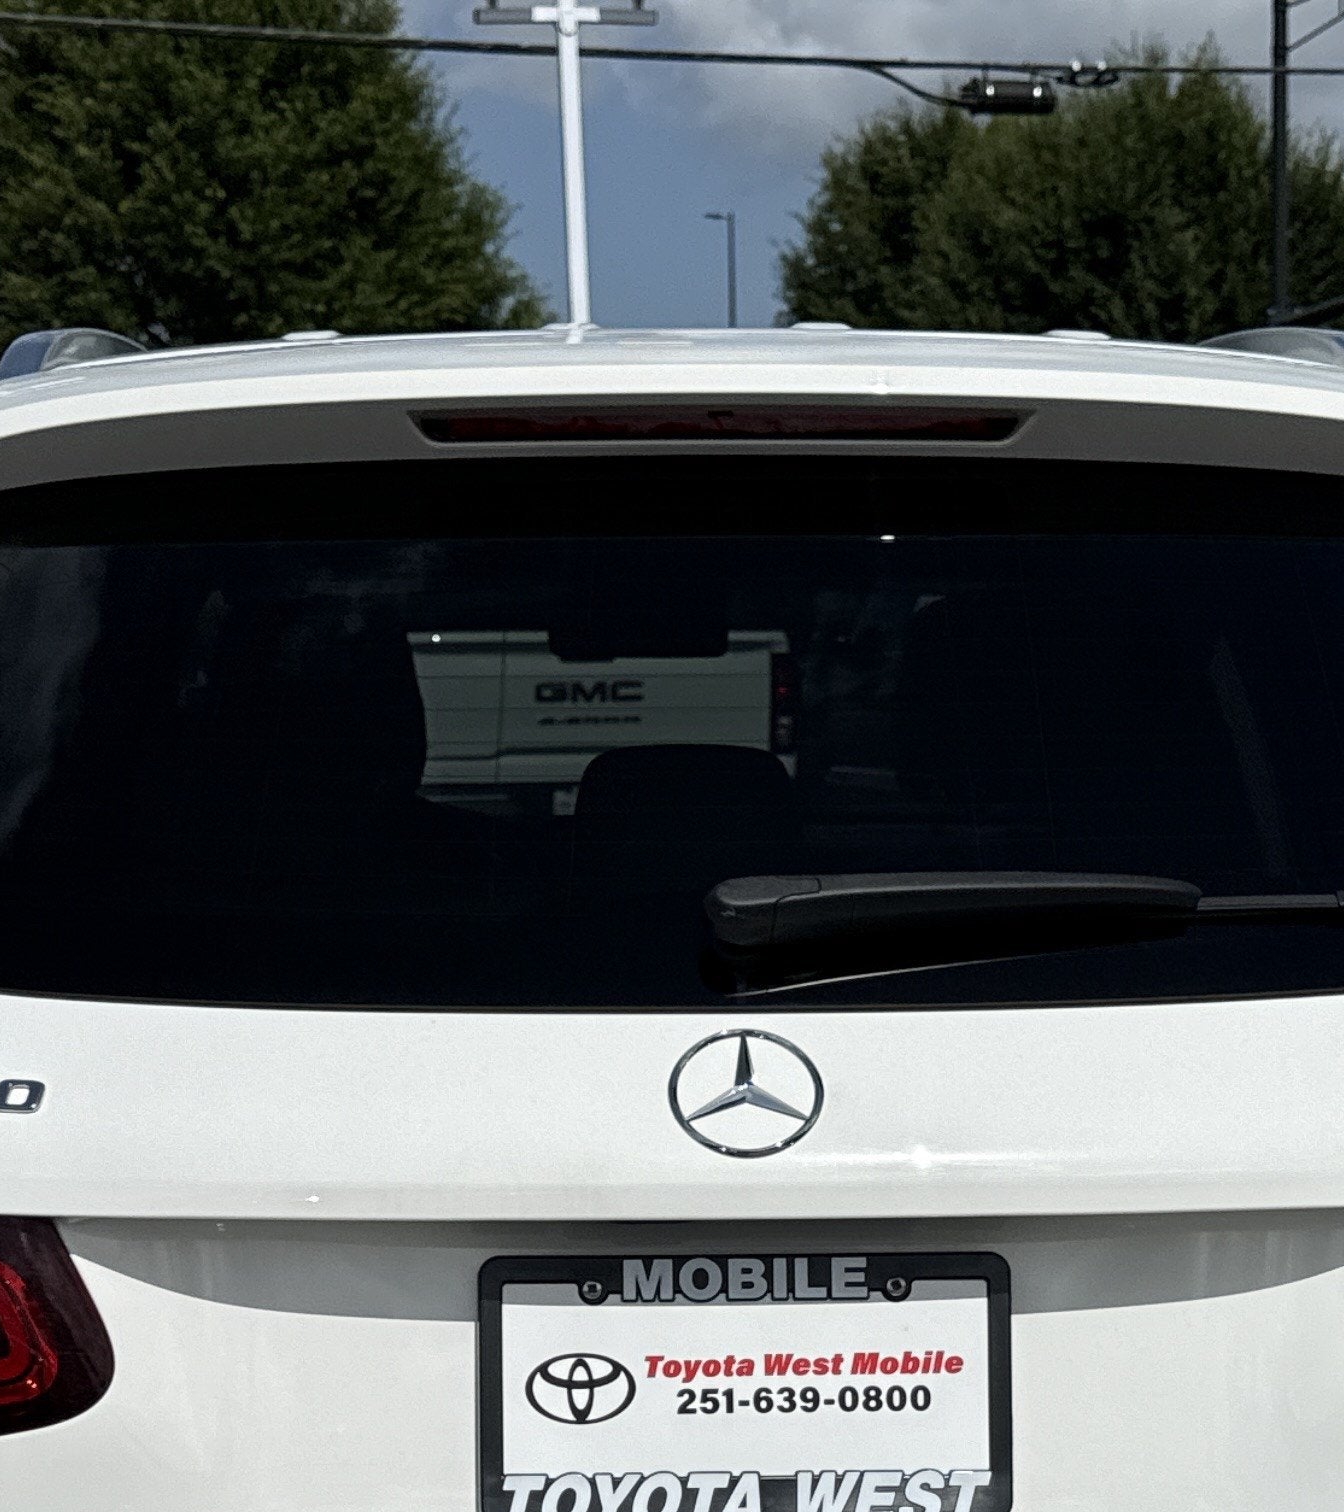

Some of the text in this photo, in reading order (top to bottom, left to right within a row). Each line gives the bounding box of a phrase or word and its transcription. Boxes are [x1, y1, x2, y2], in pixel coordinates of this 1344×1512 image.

[535, 681, 644, 703] GMC
[622, 1257, 870, 1302] MOBILE
[644, 1350, 964, 1383] Toyota West Mobile
[676, 1385, 932, 1415] 251-639-0800
